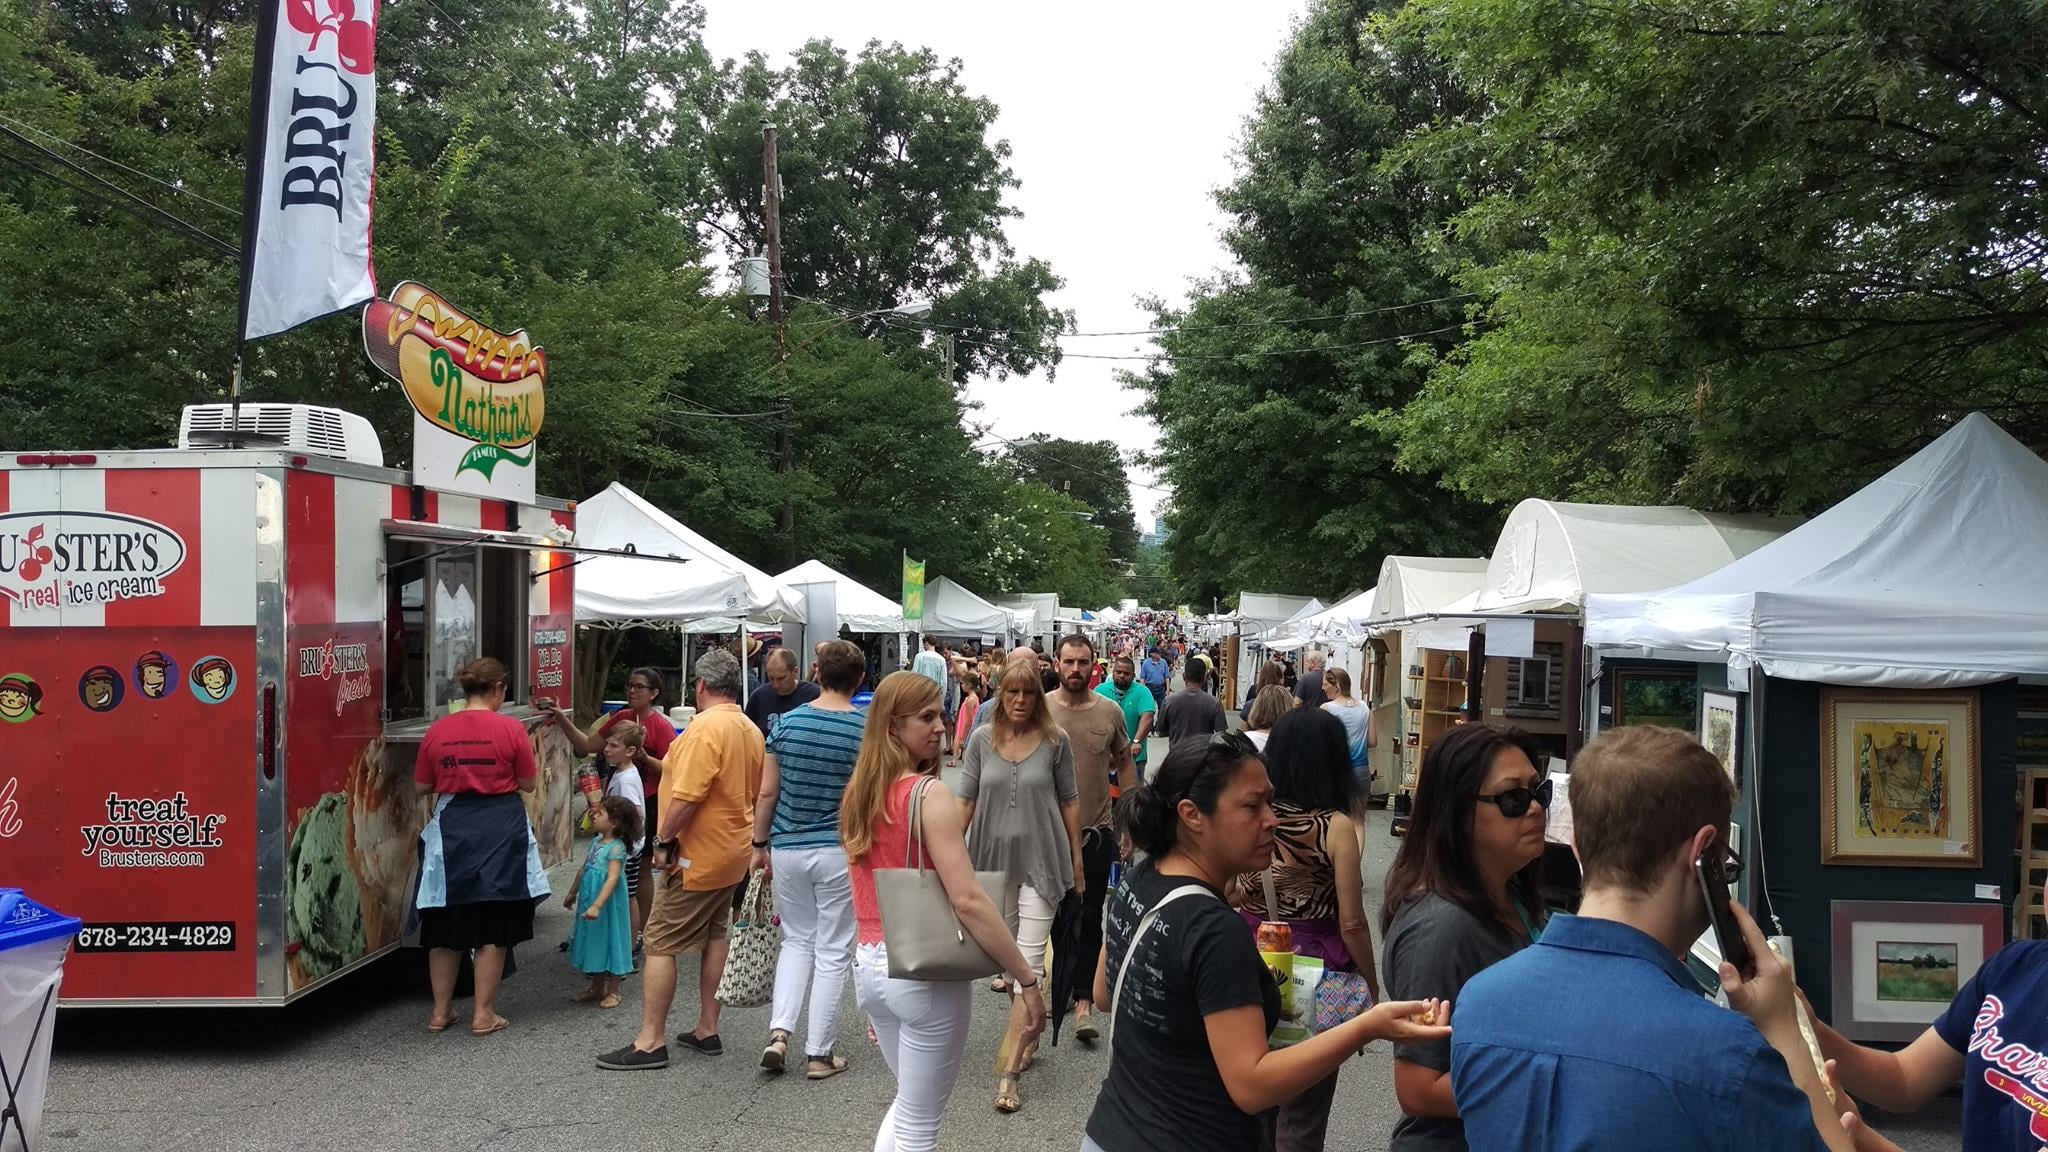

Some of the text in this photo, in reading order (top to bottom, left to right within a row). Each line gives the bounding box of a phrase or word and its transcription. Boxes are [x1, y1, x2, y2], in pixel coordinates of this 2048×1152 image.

[280, 54, 357, 223] BRU
[23, 576, 157, 609] real ice cream
[336, 664, 371, 717] fresh
[106, 792, 188, 823] treat
[100, 850, 204, 867] Brusters.com
[78, 925, 232, 947] 678-234-4829
